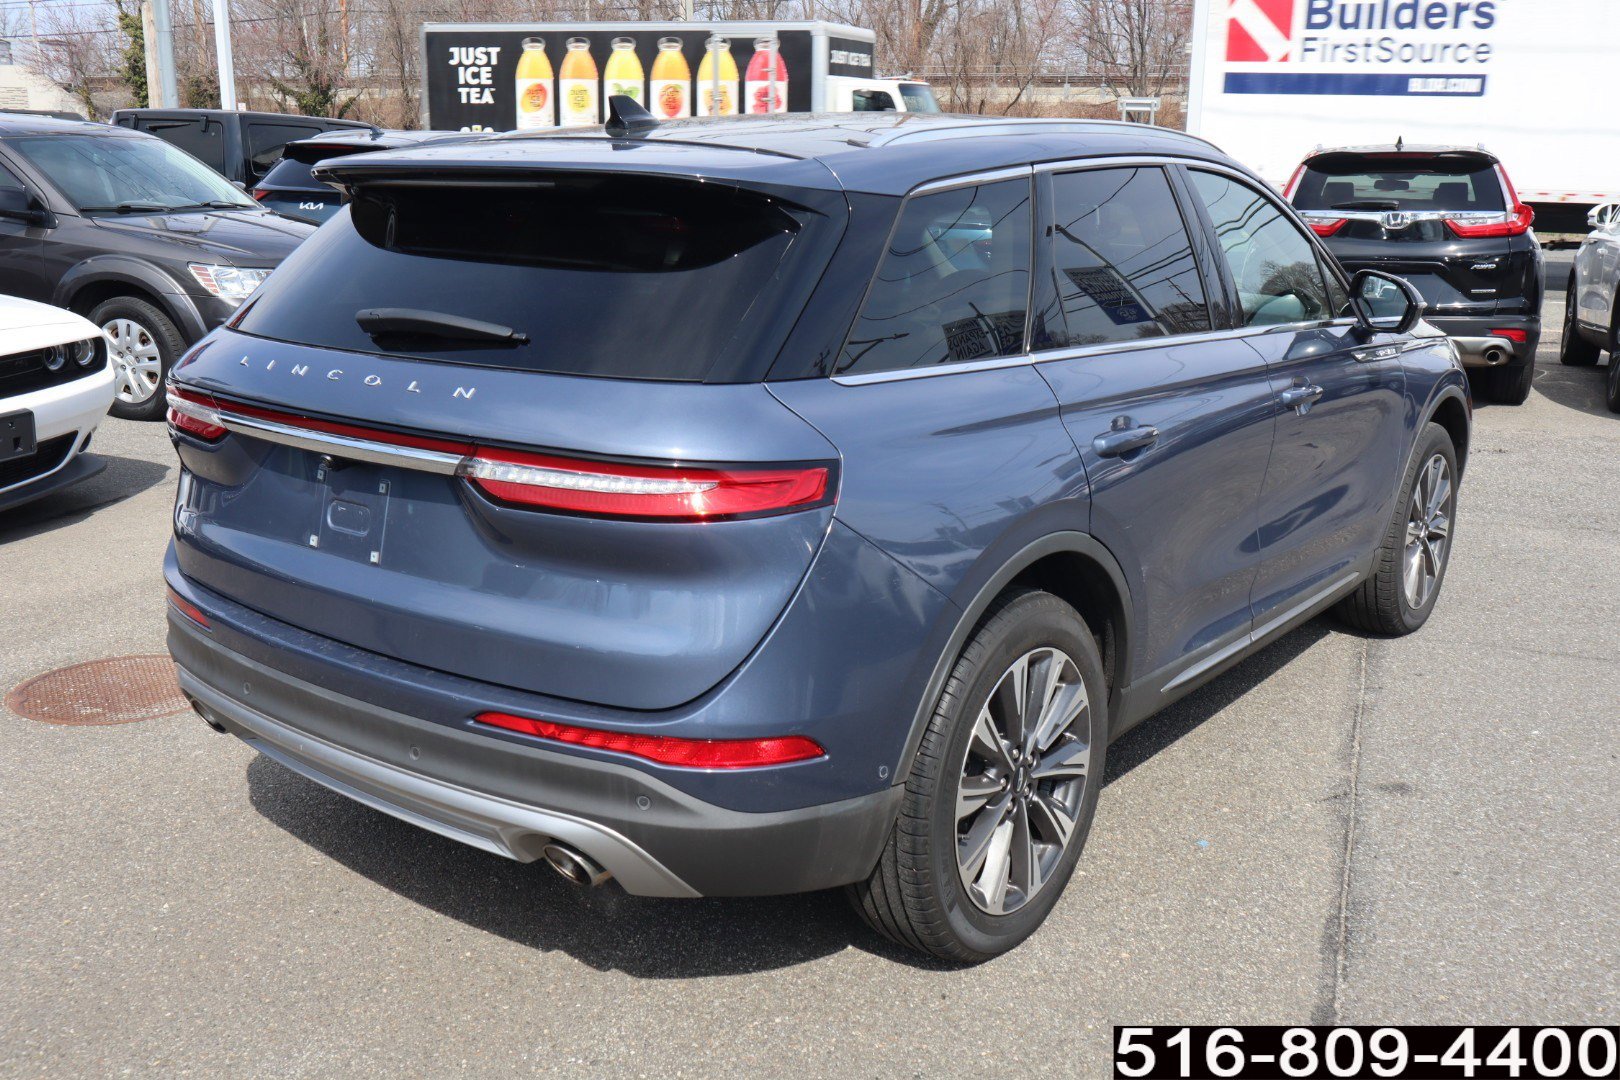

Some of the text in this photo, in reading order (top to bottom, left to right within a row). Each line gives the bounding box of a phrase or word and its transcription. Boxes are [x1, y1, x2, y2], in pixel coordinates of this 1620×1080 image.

[1305, 0, 1496, 30] Builders
[448, 46, 502, 66] JUST
[1301, 37, 1493, 64] FirstSource
[458, 66, 493, 85] ICE
[457, 87, 496, 104] TEA
[239, 355, 478, 400] LINCOLN
